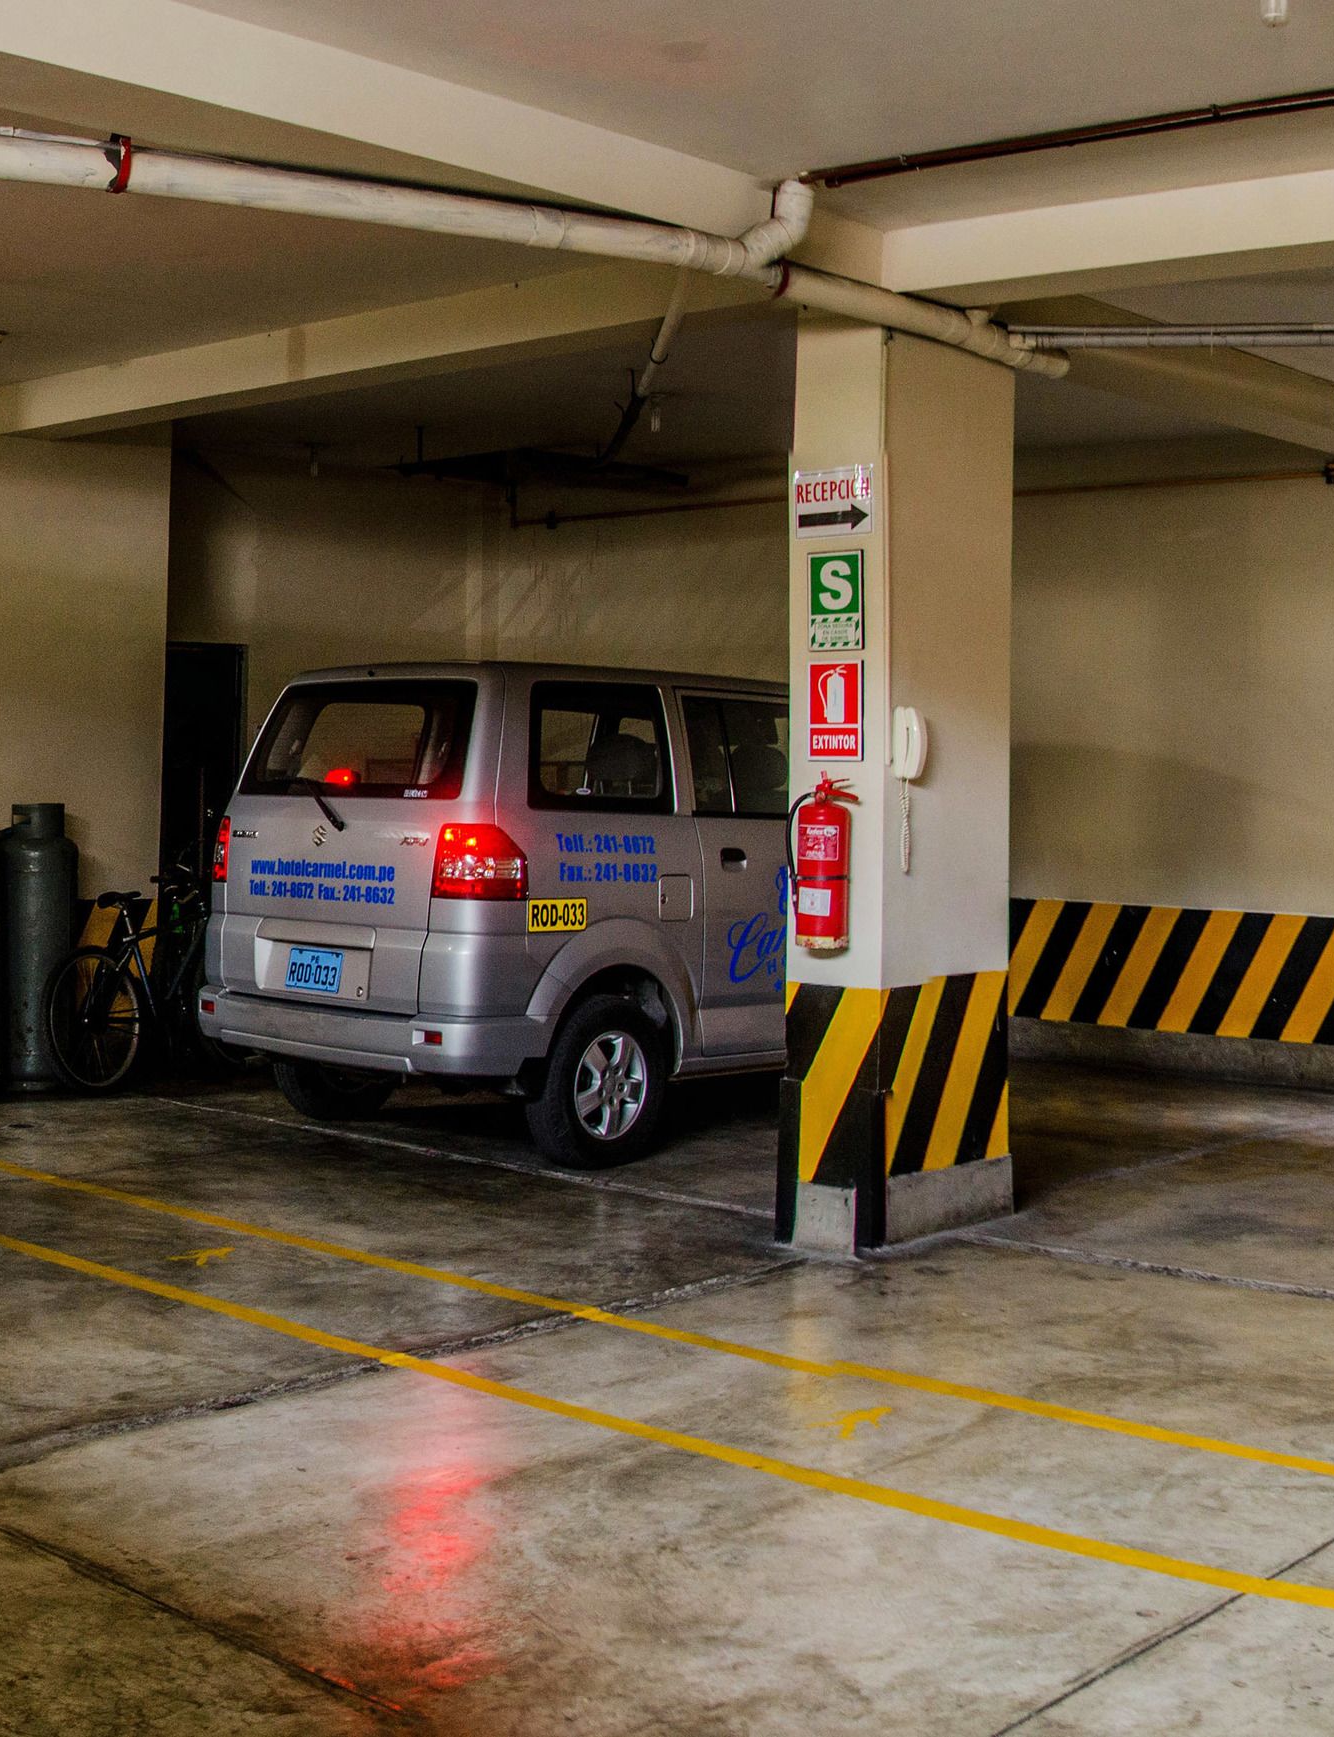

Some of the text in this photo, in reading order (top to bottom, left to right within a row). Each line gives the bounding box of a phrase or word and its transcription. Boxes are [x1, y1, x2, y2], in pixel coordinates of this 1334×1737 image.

[818, 560, 853, 610] S
[812, 734, 856, 750] EXTINTOR
[251, 858, 395, 883] www.hotelcarmel.com.pe
[594, 862, 657, 883] 241-8632
[271, 880, 314, 899] 241-8672
[343, 885, 395, 905] 241-8632
